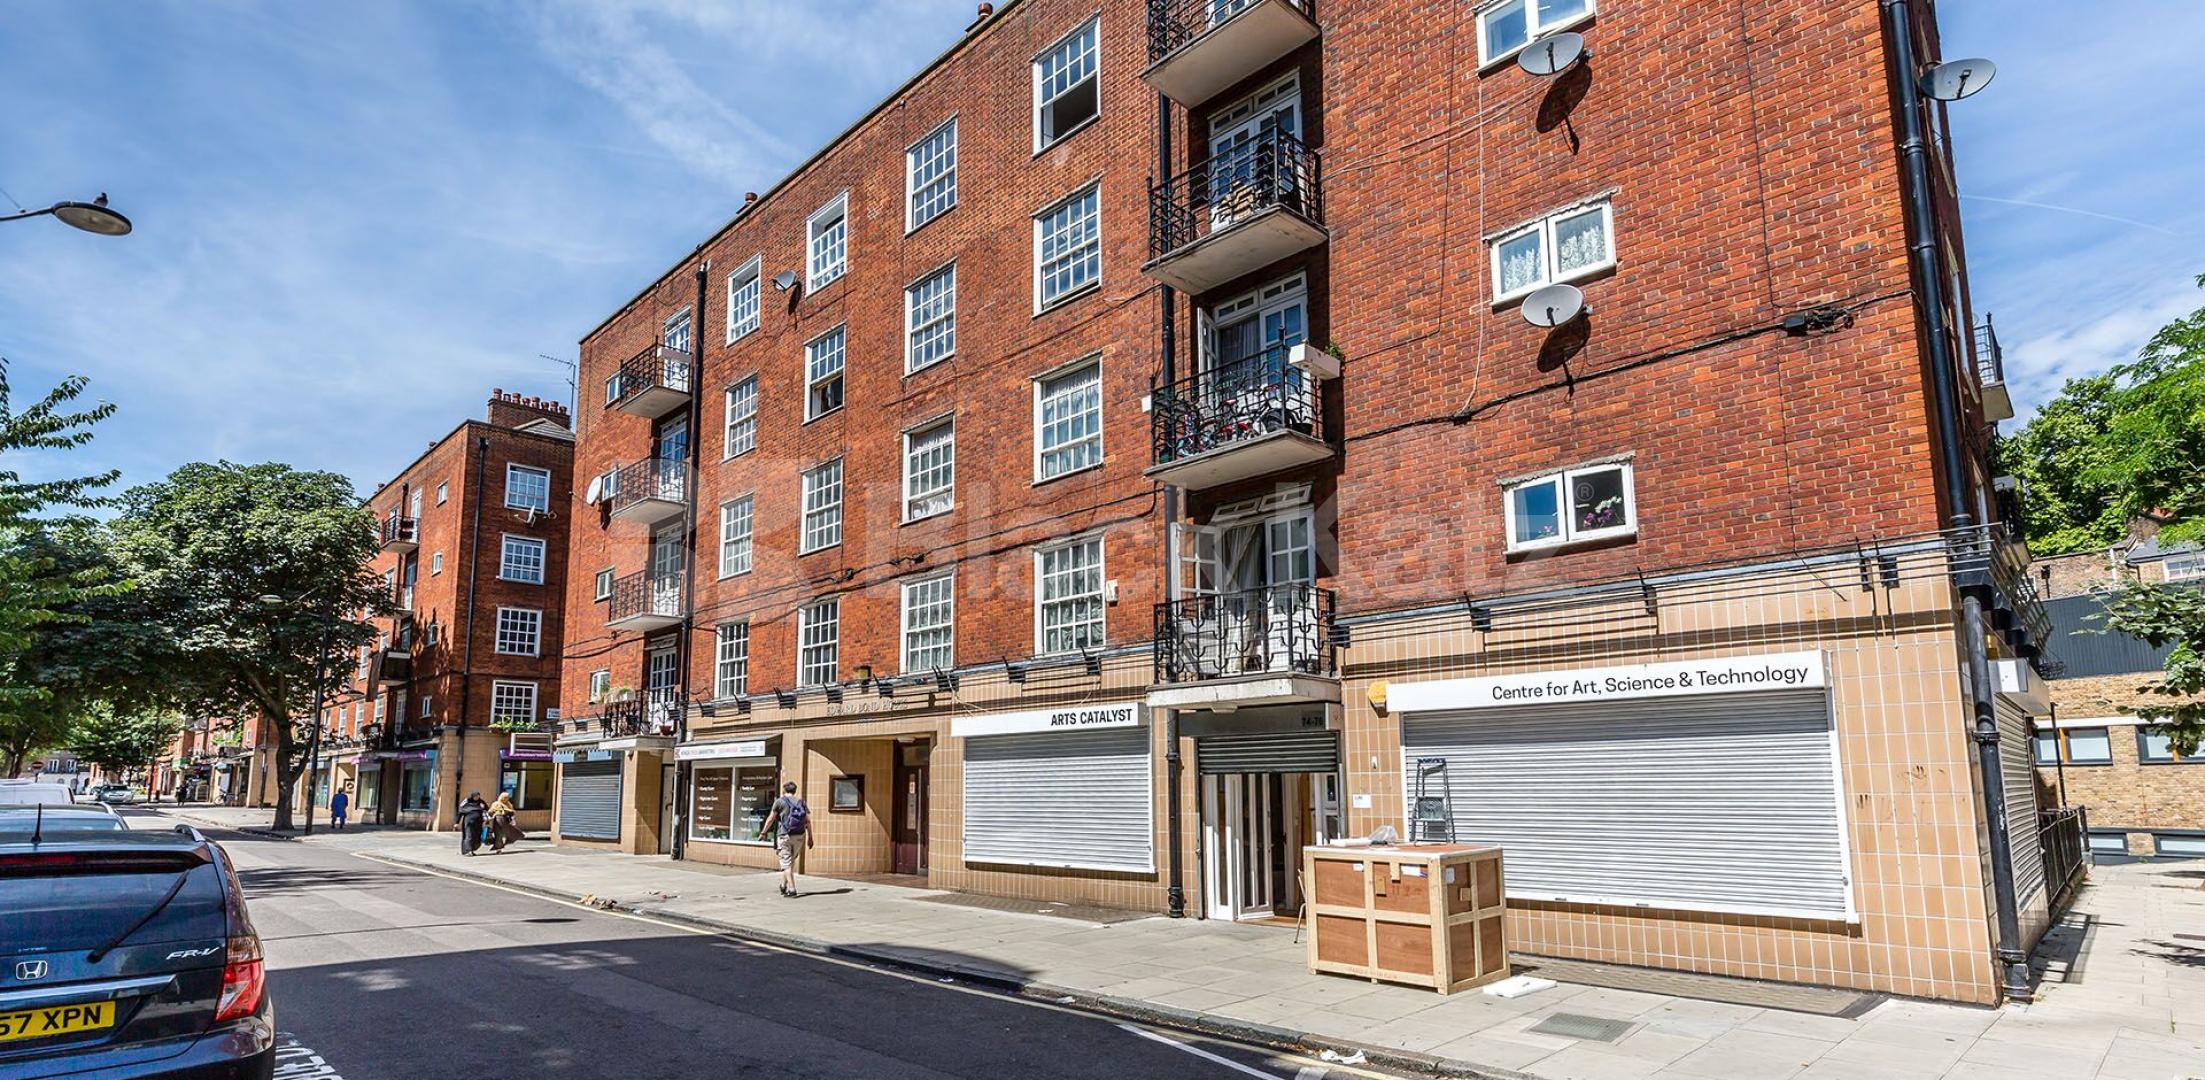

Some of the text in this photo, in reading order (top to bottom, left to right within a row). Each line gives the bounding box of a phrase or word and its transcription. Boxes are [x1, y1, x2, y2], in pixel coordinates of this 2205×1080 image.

[1492, 665, 1809, 700] Centre for Art, Science & Technology
[1050, 708, 1133, 726] ARTS CATALYST
[165, 946, 220, 960] FR-V
[41, 1004, 101, 1031] XPN
